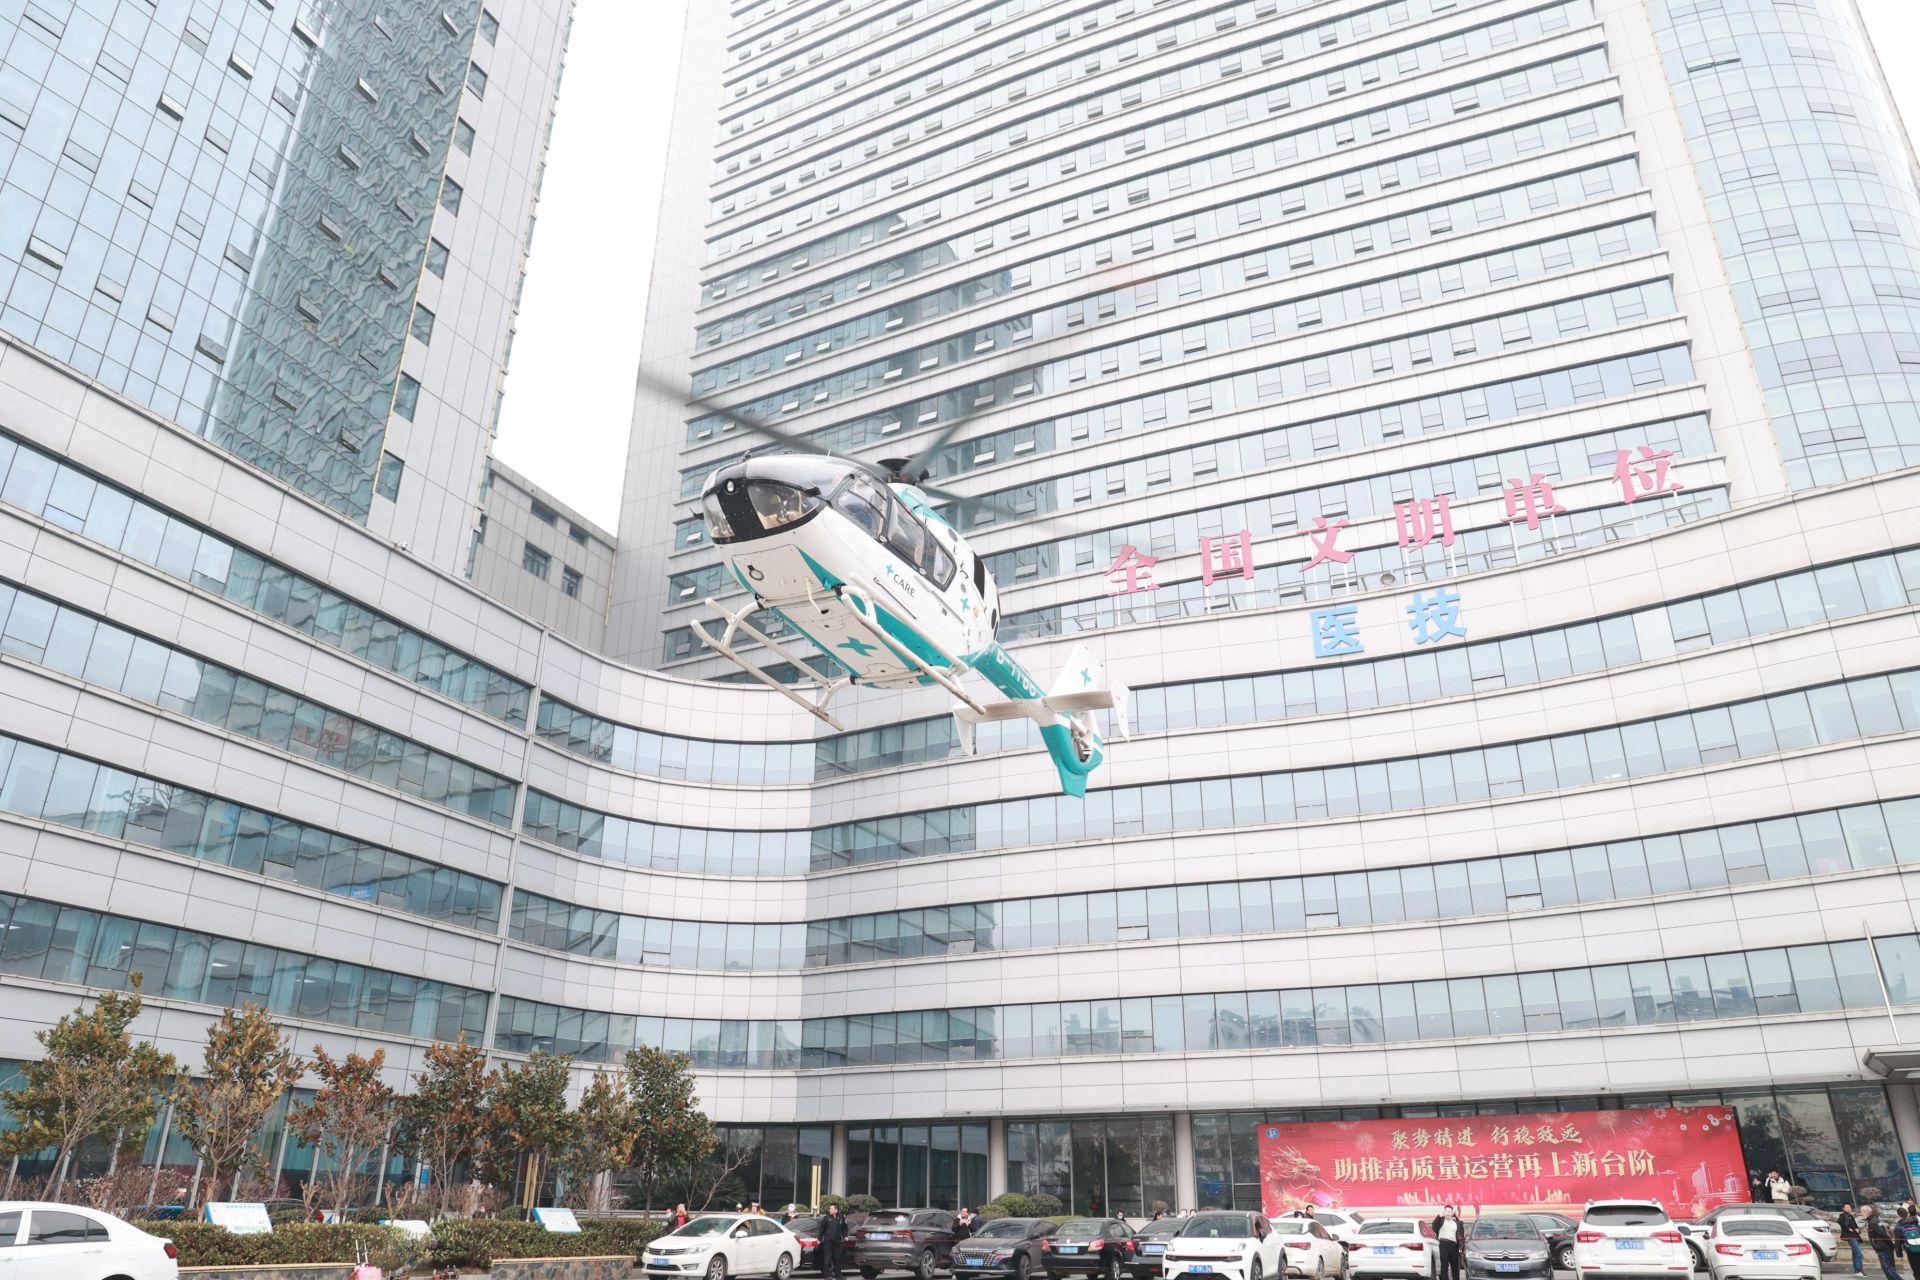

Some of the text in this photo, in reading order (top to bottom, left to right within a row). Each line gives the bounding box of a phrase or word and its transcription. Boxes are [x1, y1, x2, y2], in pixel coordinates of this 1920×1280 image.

[1105, 446, 1685, 596] 全国文明单位
[893, 574, 917, 598] CARE
[1311, 589, 1468, 658] 医技
[1391, 1123, 1584, 1151] 聚势精进 行稳致远
[1334, 1149, 1656, 1183] 助推高质量运营再上新台阶
